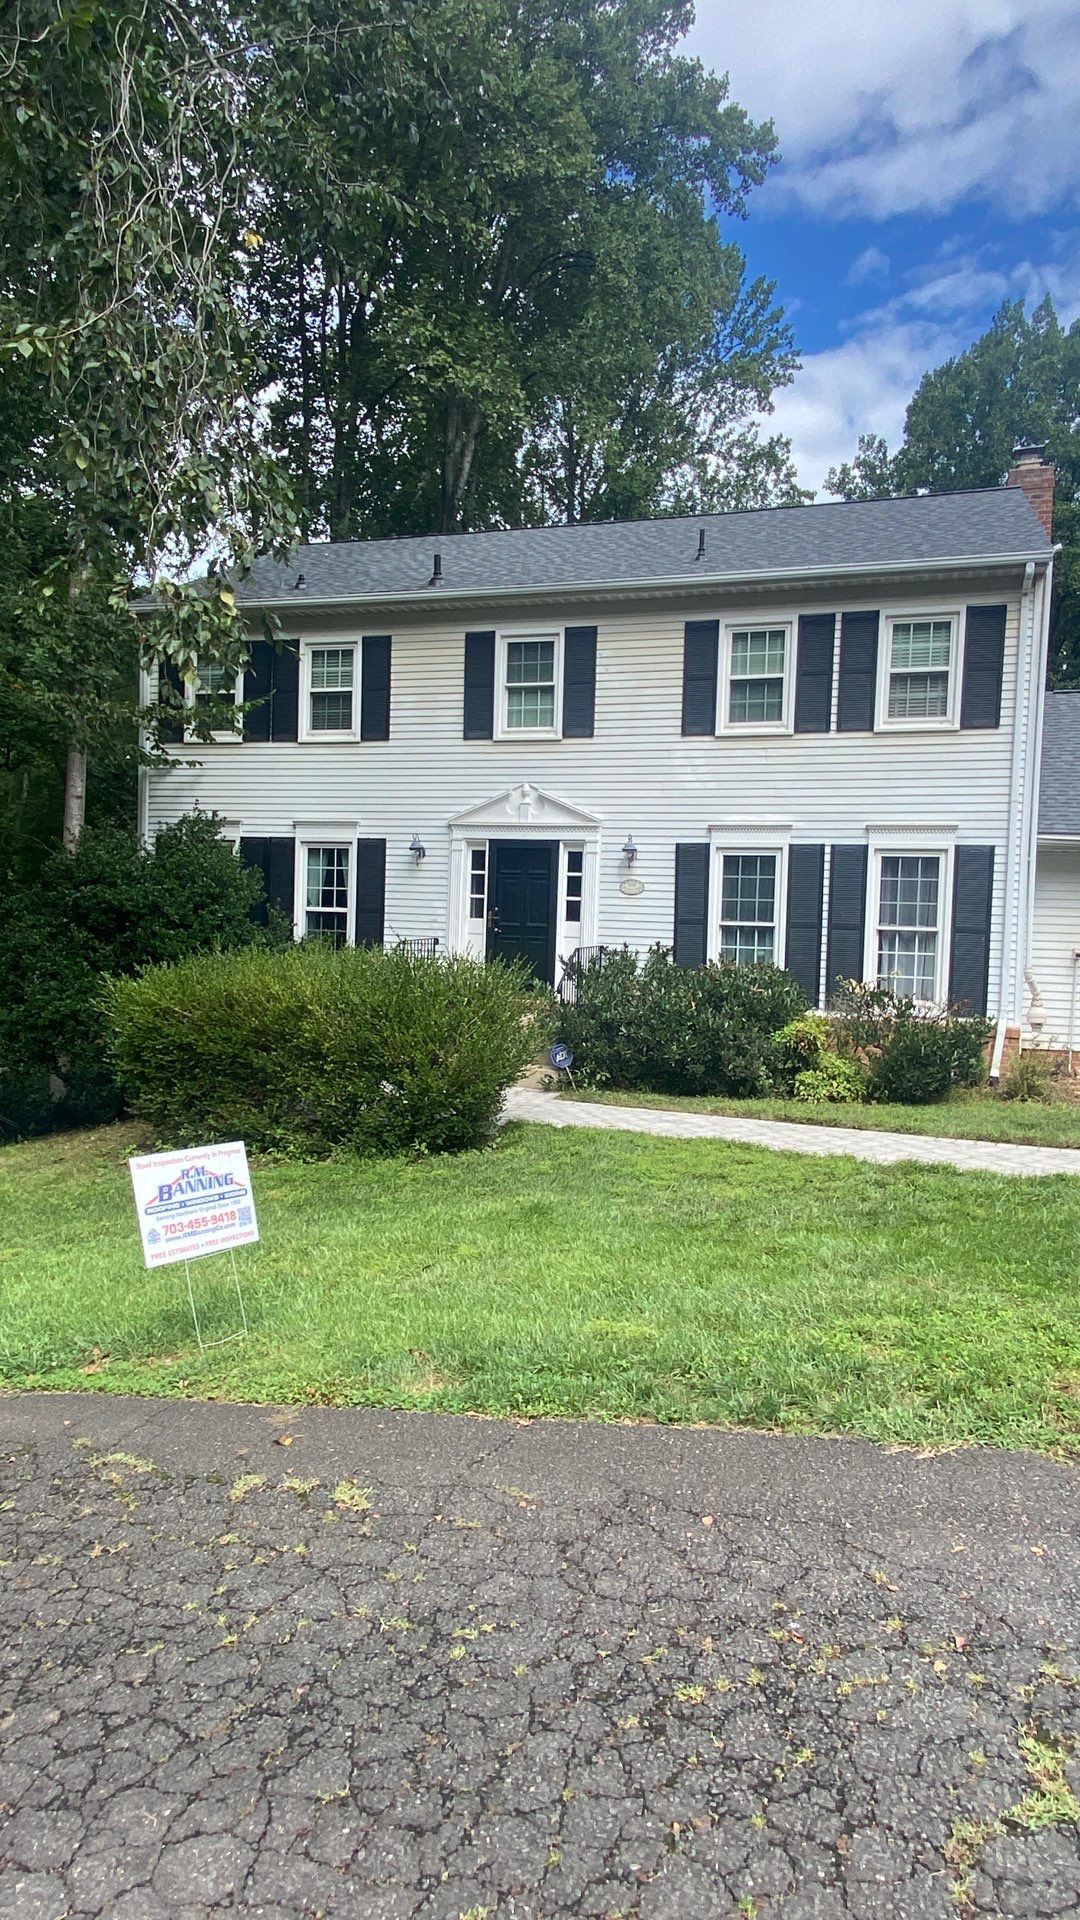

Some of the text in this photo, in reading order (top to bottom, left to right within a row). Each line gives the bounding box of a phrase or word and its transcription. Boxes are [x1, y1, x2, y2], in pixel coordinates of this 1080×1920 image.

[136, 1161, 151, 1170] Roof
[152, 1157, 184, 1168] Inspection
[184, 1152, 210, 1162] Currently
[218, 1148, 240, 1158] Progress
[158, 1172, 234, 1202] BANNING
[146, 1202, 180, 1214] ROOFING
[186, 1194, 219, 1206] WINDOWS
[156, 1213, 176, 1222] Serving
[162, 1210, 236, 1236] 703-455-9418
[166, 1222, 236, 1242] www.RMBanningCo.com
[151, 1230, 254, 1260] FREE ESTIMATES FREE INSPECTIONS
